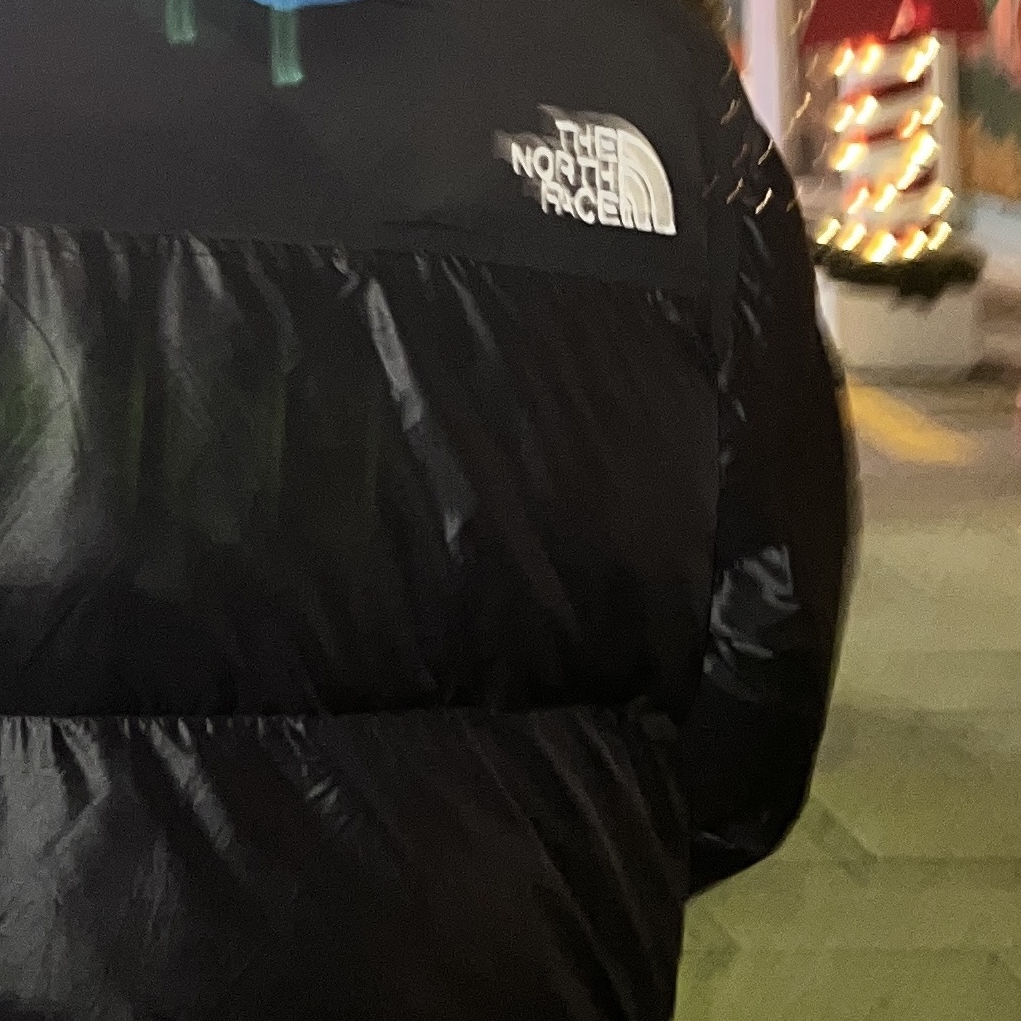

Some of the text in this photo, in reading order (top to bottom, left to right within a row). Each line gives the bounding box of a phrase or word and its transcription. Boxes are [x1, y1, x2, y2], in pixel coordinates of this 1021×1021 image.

[554, 120, 619, 161] THE
[511, 142, 620, 195] NORTH
[541, 179, 621, 227] FACE
